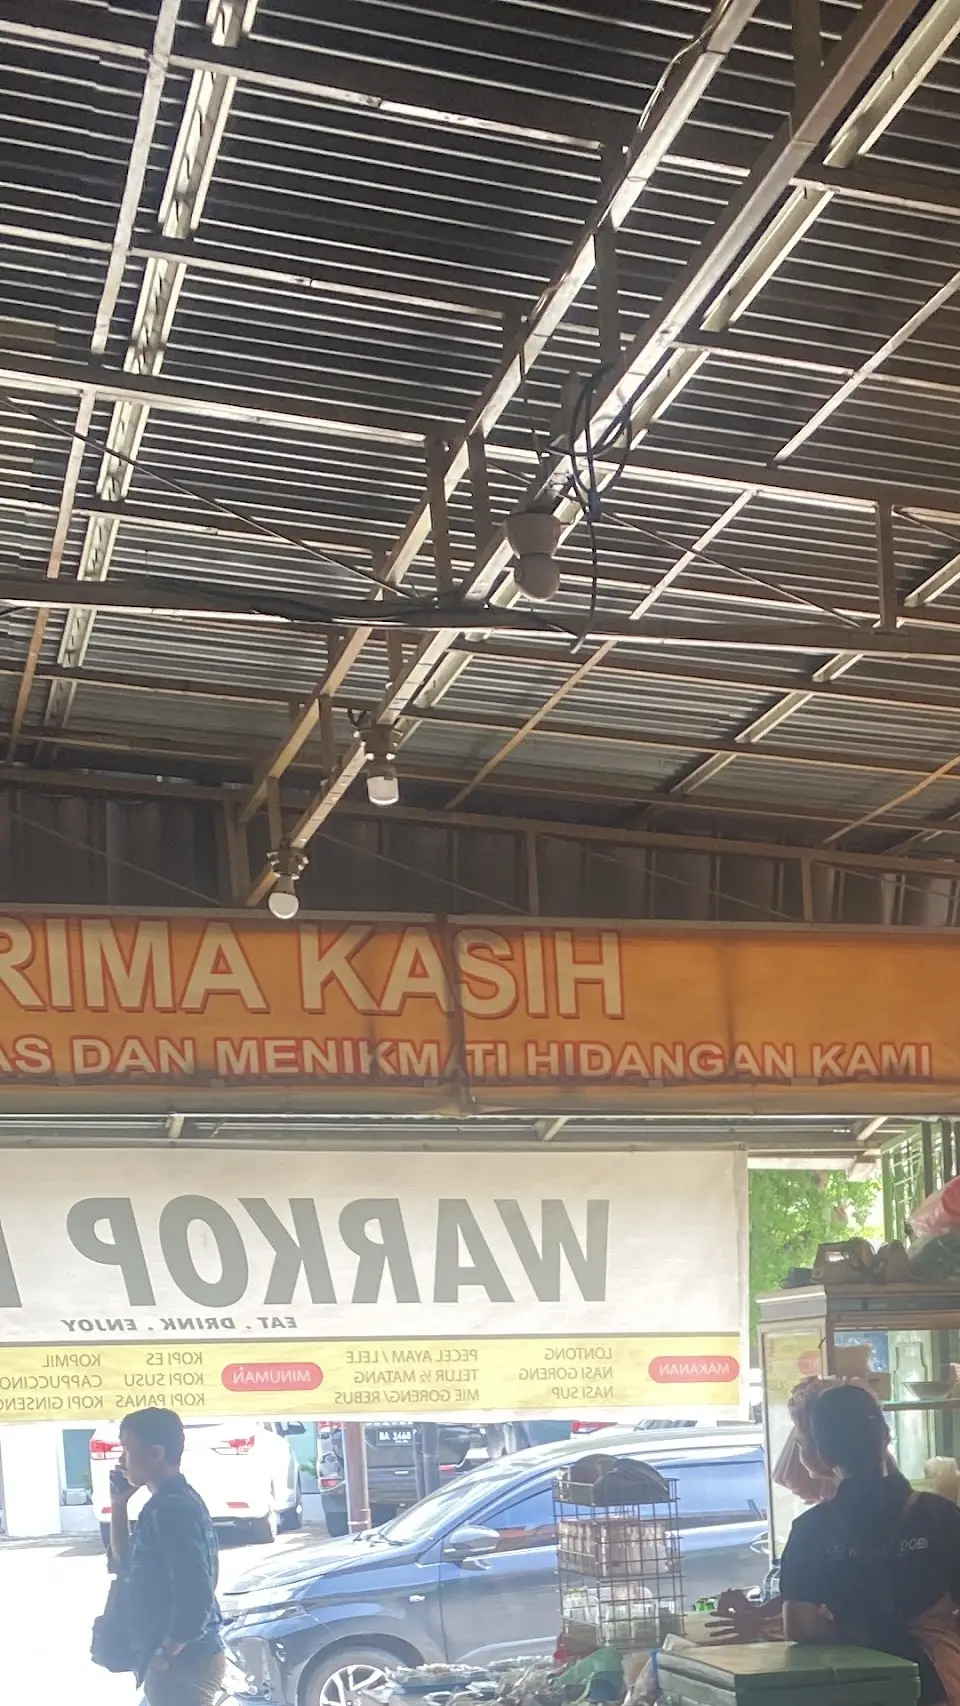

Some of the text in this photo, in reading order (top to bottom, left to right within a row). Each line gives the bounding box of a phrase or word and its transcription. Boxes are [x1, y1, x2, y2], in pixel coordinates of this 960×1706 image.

[299, 921, 625, 1020] KASIH
[70, 1035, 196, 1077] DAN
[214, 1037, 510, 1082] MENIKMATI
[525, 1040, 797, 1080] HIDANGAN
[812, 1042, 933, 1080] KAMI
